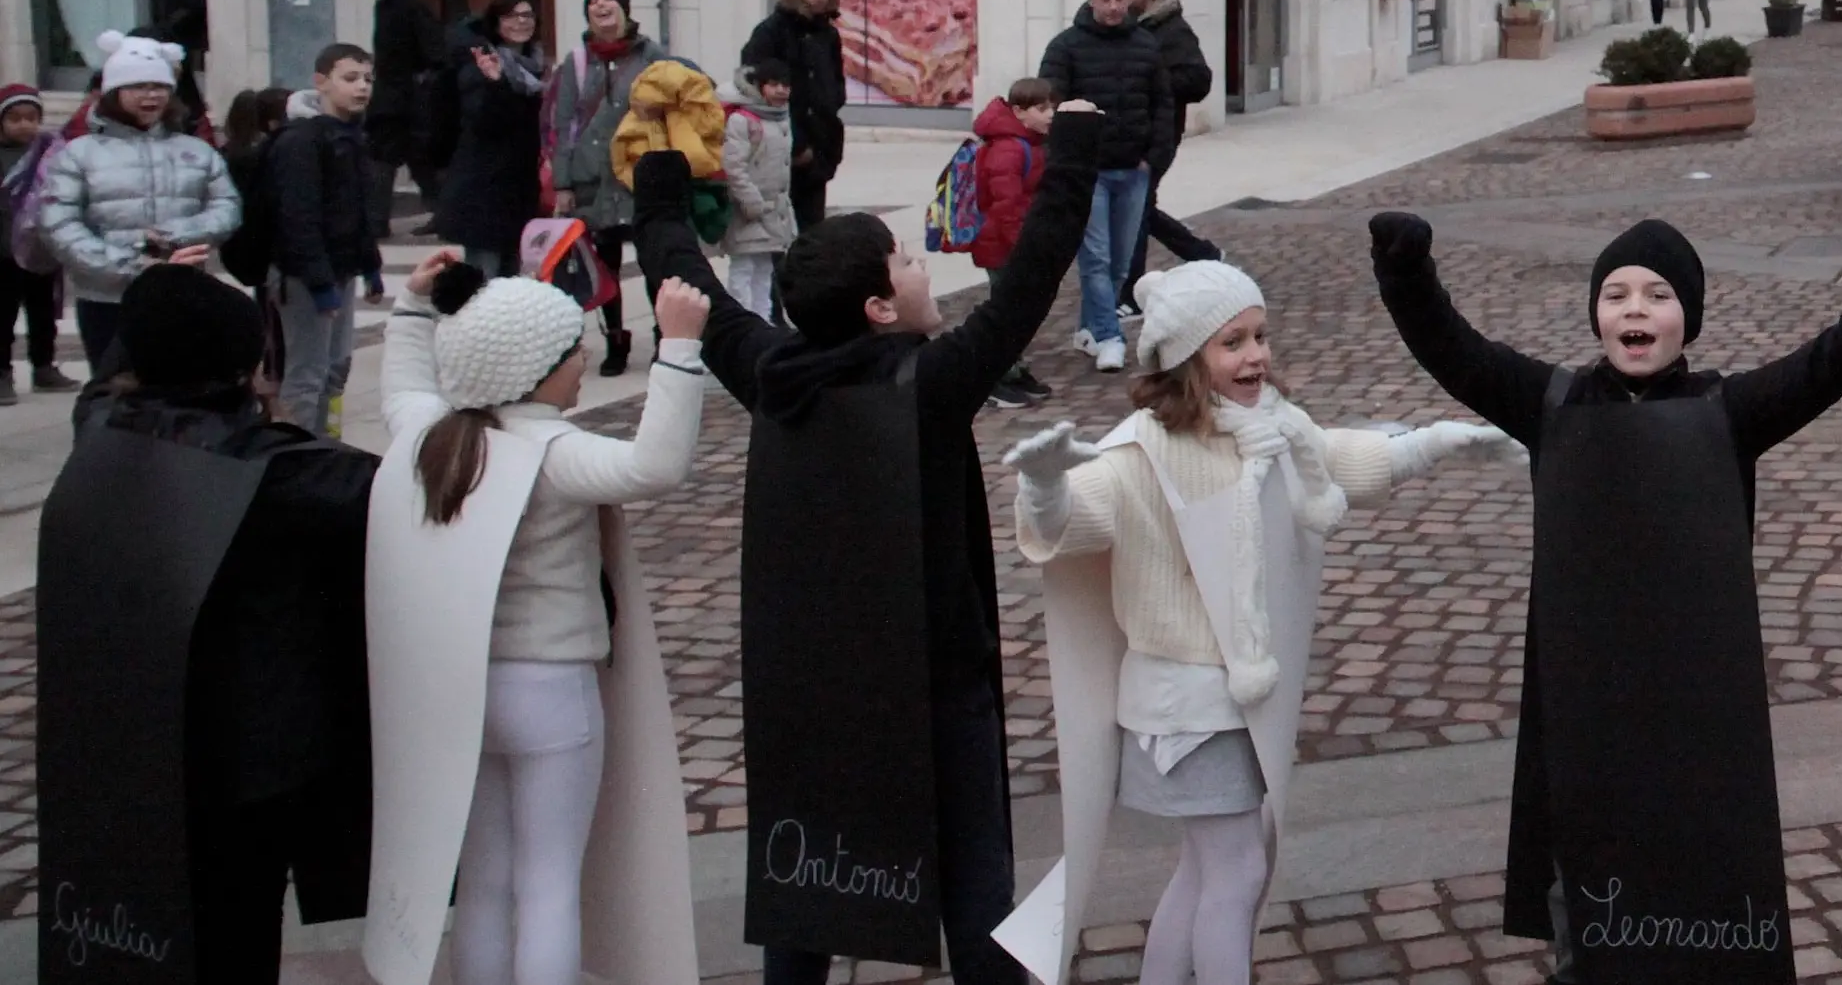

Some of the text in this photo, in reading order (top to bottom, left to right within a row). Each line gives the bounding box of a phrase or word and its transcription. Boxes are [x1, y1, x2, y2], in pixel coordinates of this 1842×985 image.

[763, 819, 923, 904] Antonio
[50, 881, 173, 967] Giulia
[1580, 876, 1780, 952] Leonardo
